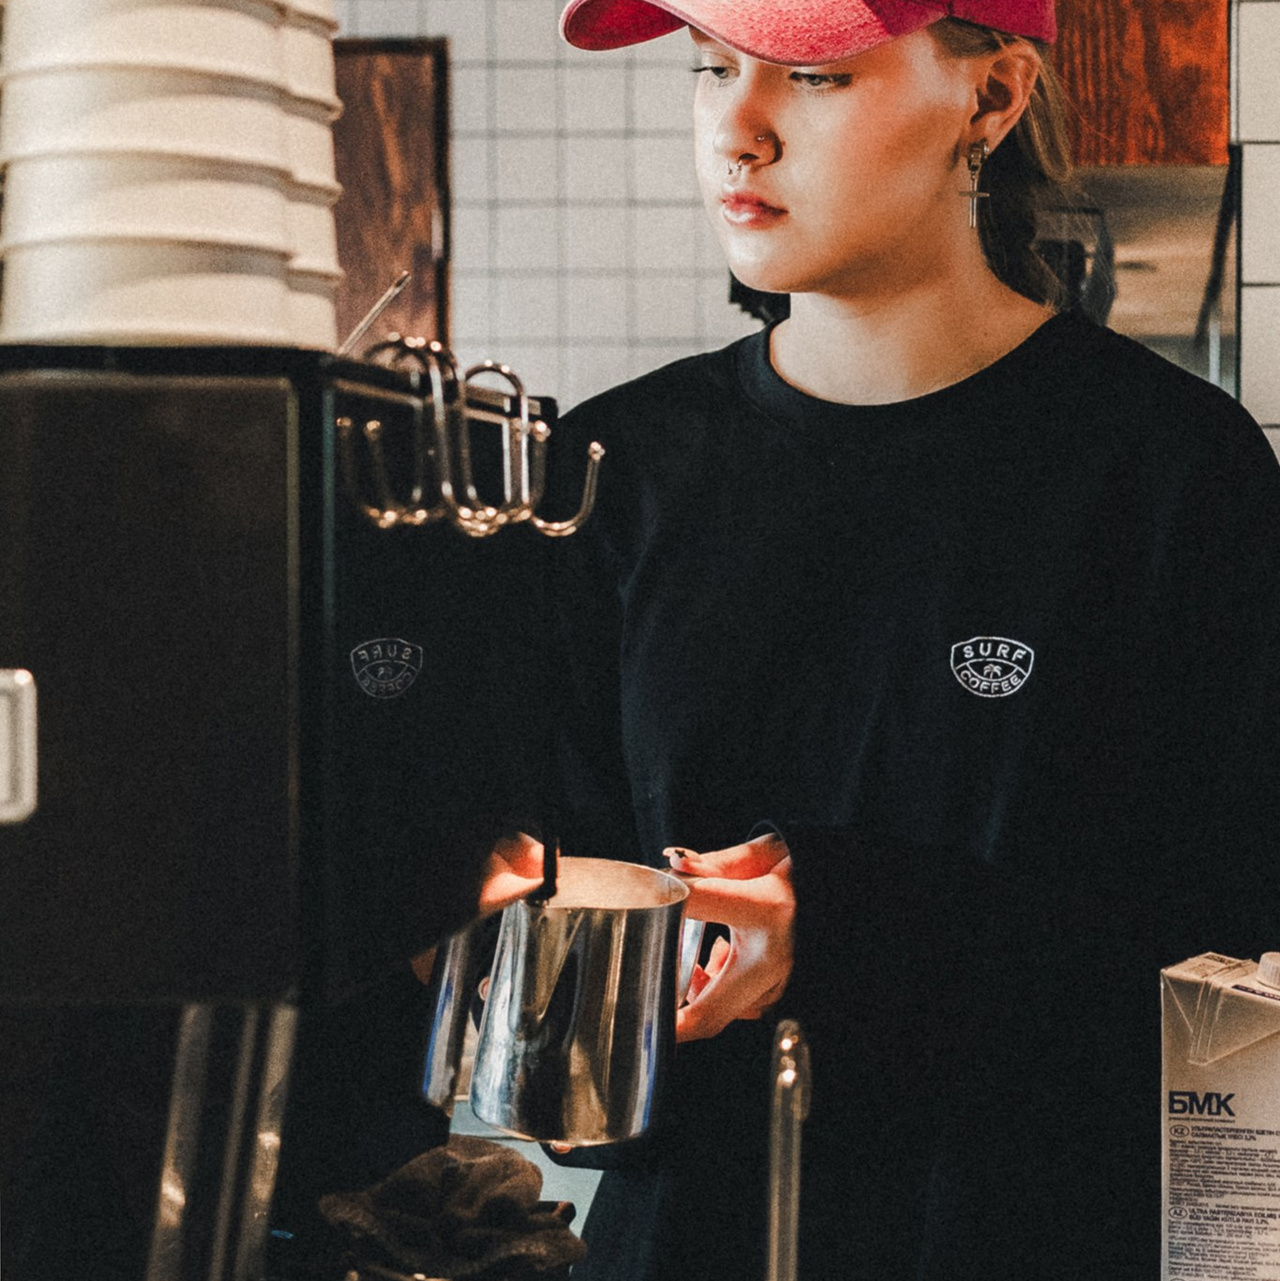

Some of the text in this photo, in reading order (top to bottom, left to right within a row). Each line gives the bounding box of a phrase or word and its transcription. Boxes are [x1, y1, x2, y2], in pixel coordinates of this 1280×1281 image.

[963, 642, 1027, 661] SURF
[960, 670, 1021, 694] COFFEE
[1168, 1091, 1236, 1117] БМК
[1173, 1127, 1186, 1136] KZ
[1173, 1208, 1183, 1217] AZ
